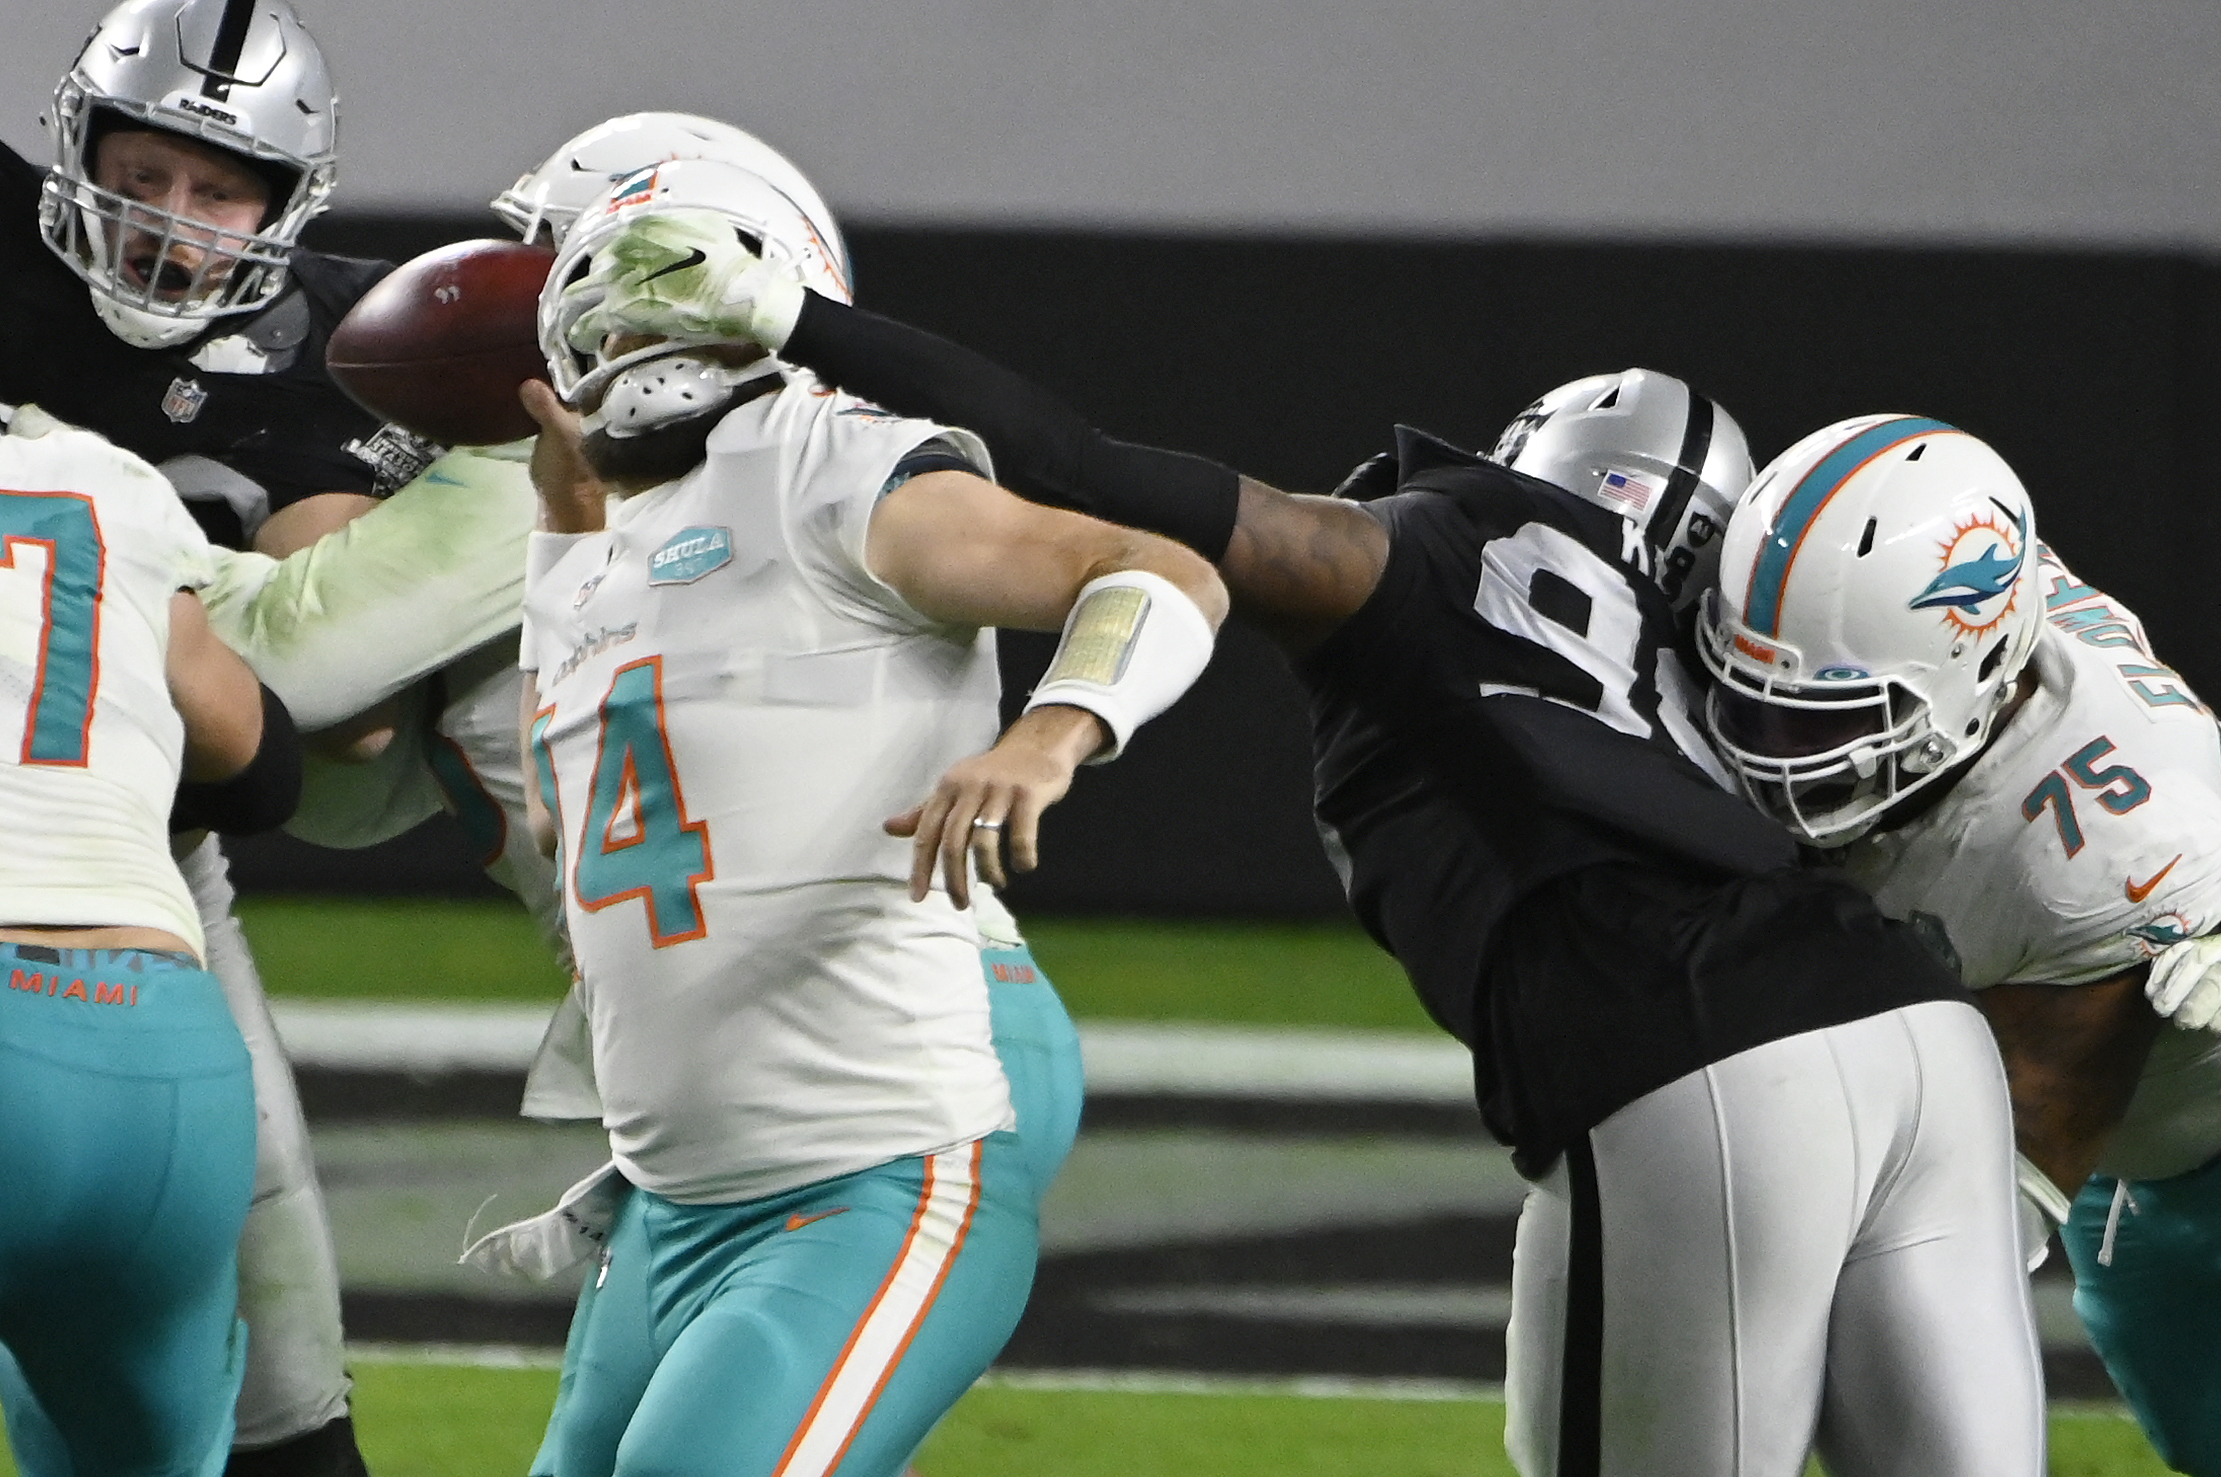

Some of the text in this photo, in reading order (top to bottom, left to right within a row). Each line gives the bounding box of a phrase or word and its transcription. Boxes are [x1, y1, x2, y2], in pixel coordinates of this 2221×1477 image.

[180, 98, 237, 125] RAIDERS
[653, 533, 725, 569] SHULA
[2021, 734, 2152, 860] 75
[9, 968, 138, 1007] MIAMI
